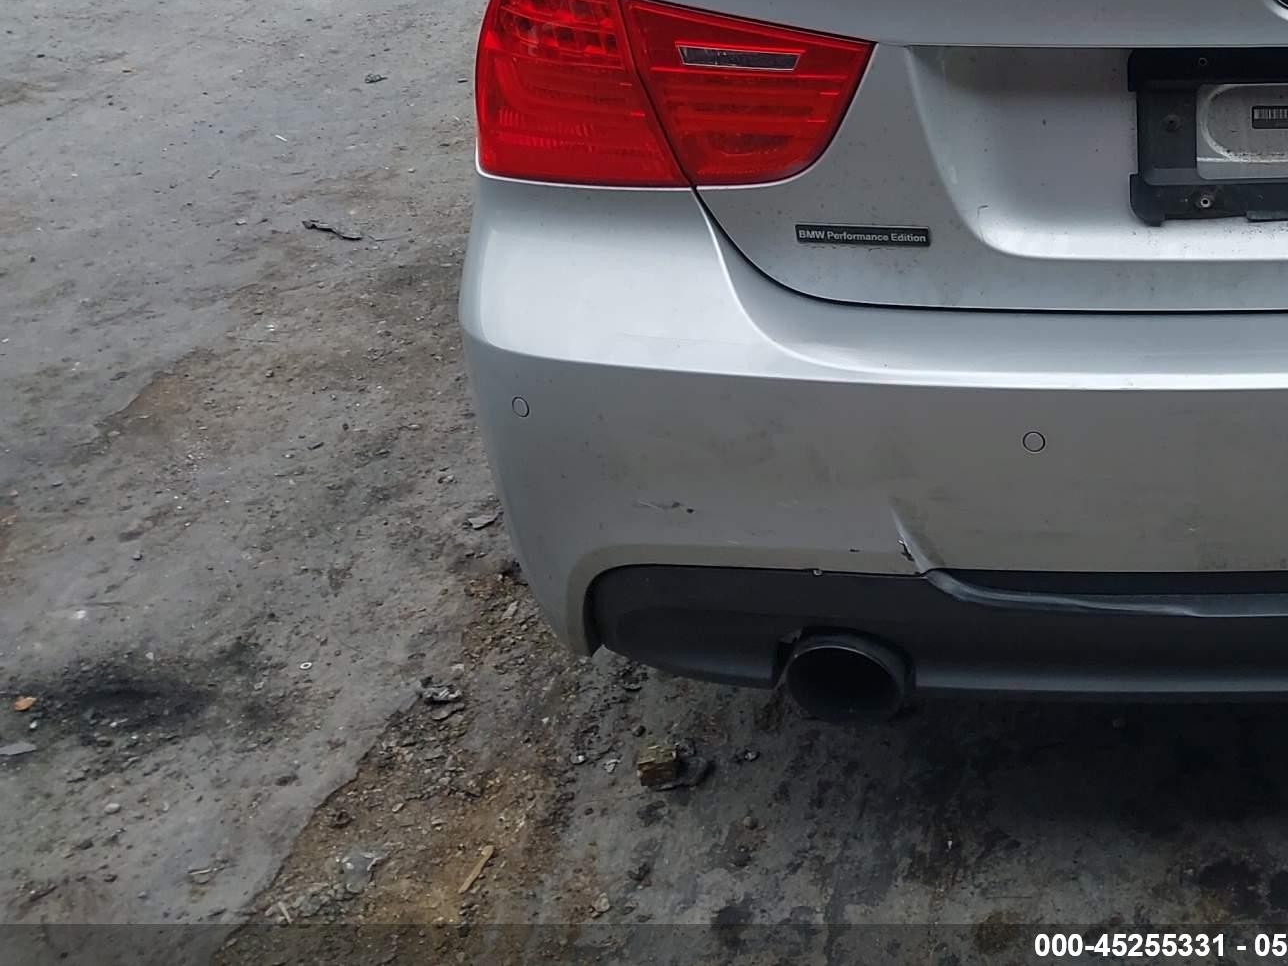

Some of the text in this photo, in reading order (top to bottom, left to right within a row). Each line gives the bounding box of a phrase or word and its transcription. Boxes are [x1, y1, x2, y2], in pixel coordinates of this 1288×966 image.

[798, 228, 928, 242] BMW Performance Edition
